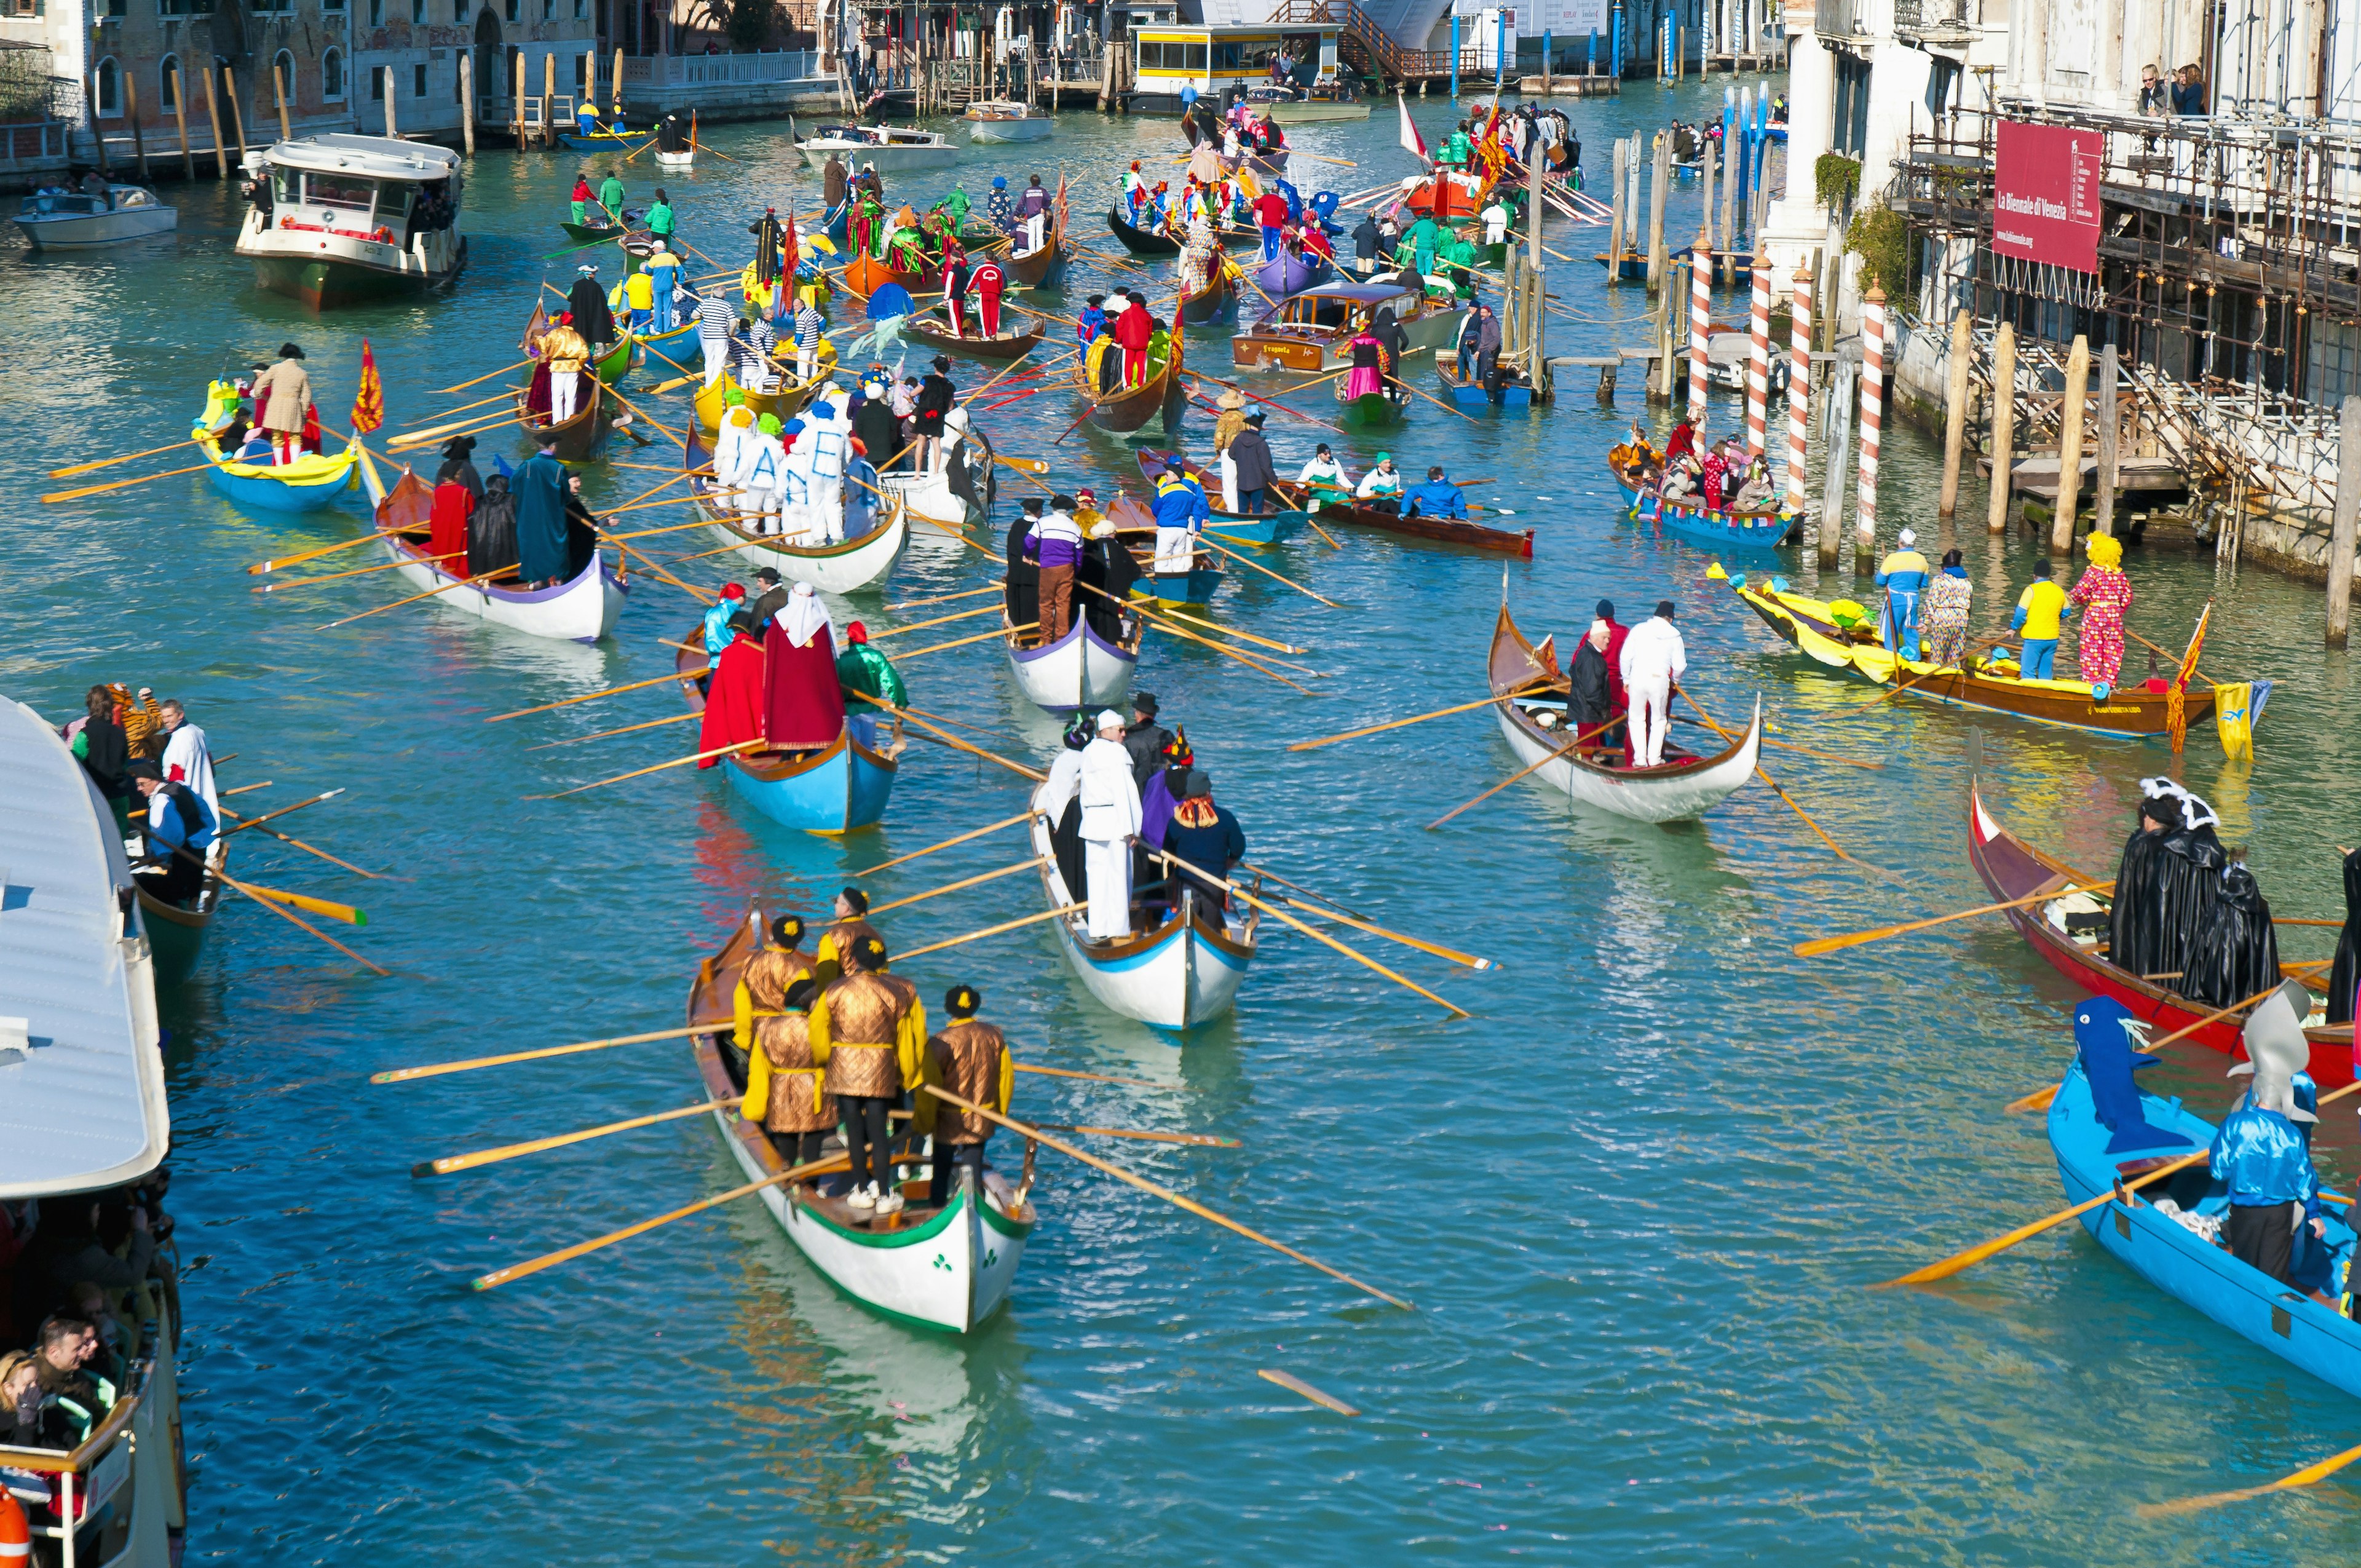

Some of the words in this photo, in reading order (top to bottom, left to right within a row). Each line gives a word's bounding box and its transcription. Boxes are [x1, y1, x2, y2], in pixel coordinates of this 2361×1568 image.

[1998, 191, 2005, 209] La
[2006, 192, 2033, 215] Biennale
[2034, 197, 2041, 216] di
[2041, 198, 2066, 220] Venezia
